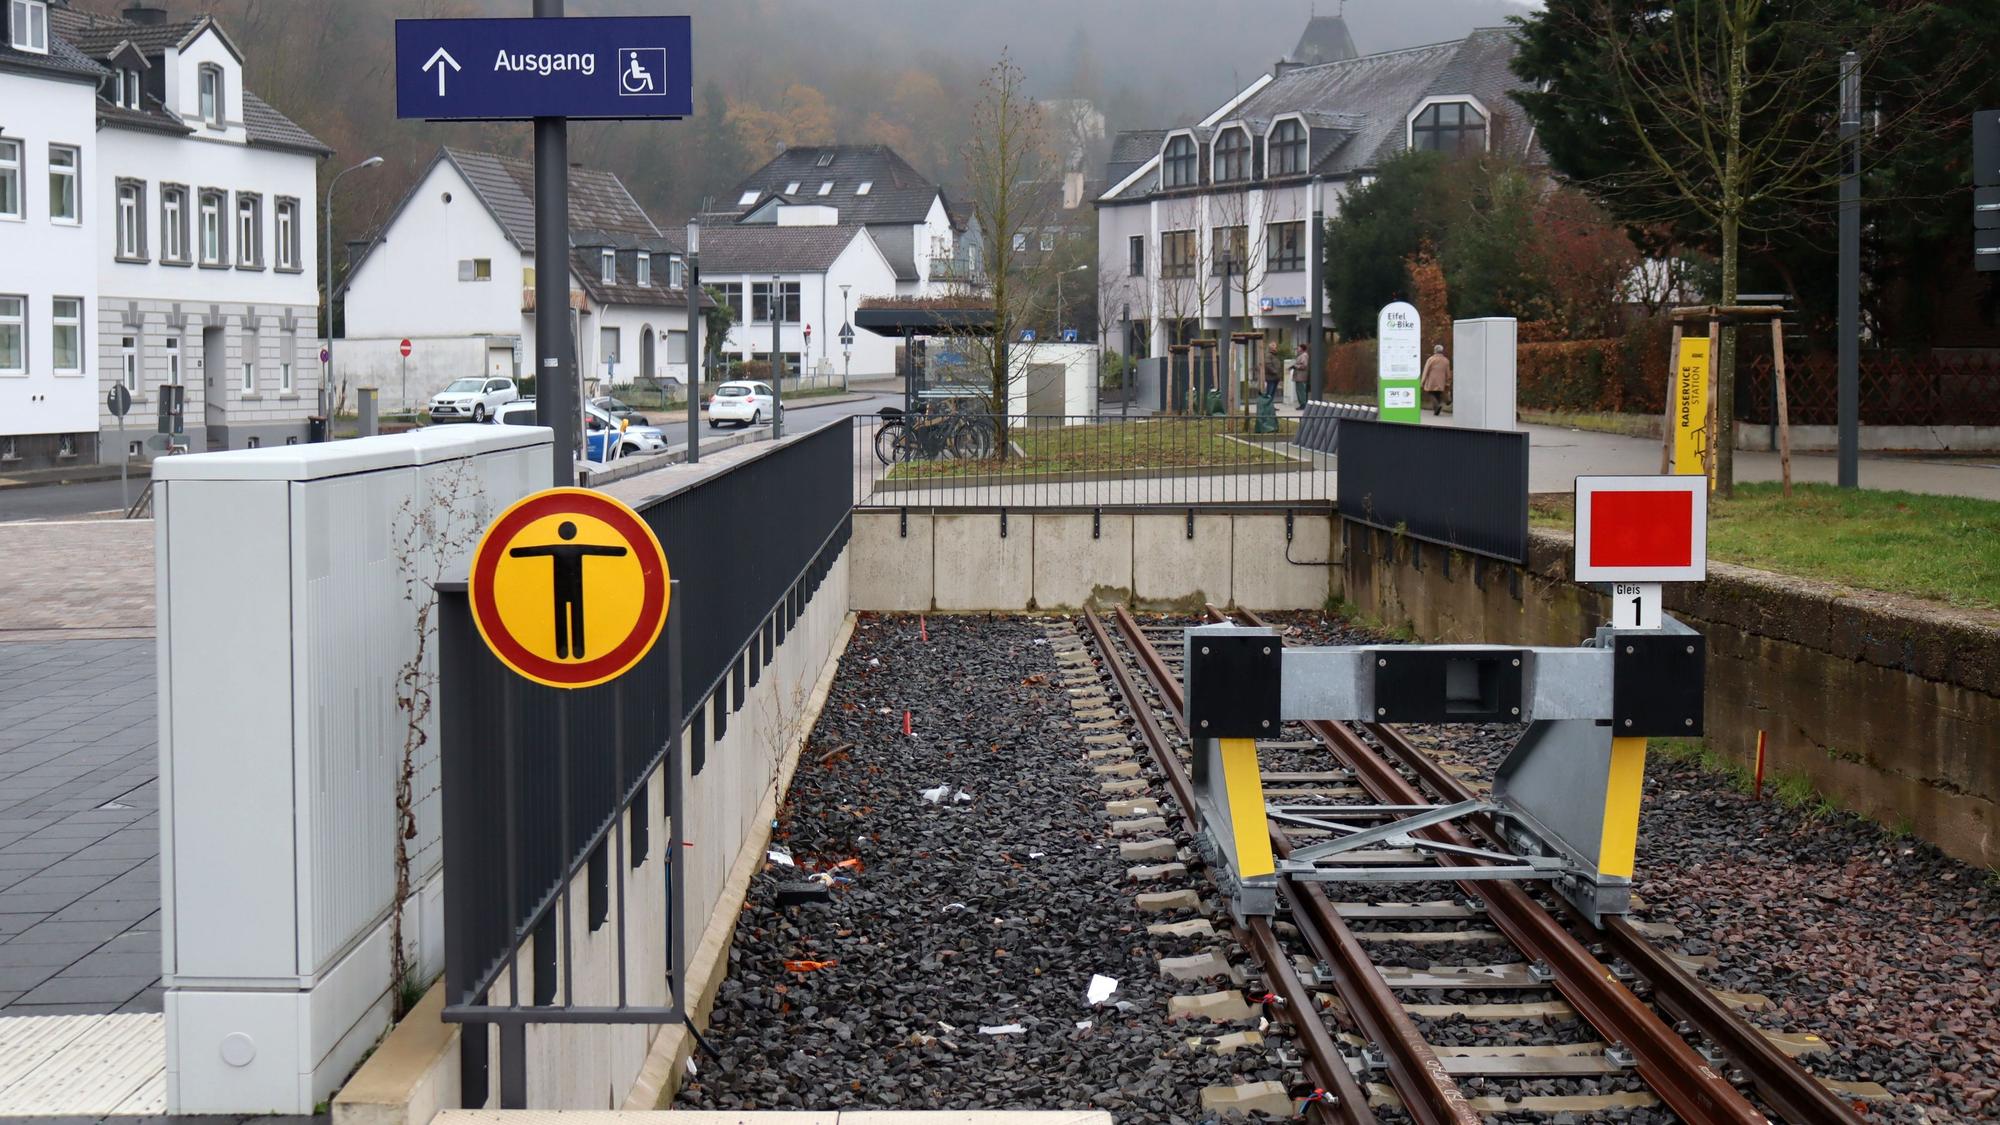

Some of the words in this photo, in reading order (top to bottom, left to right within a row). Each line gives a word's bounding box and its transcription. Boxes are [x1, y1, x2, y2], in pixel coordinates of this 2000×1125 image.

[494, 49, 595, 76] Ausgang
[1387, 312, 1406, 320] Eifel
[1681, 366, 1691, 428] RADSERVICE
[1691, 366, 1700, 405] STATION
[1616, 583, 1641, 595] Gleis
[1631, 596, 1642, 627] 1
